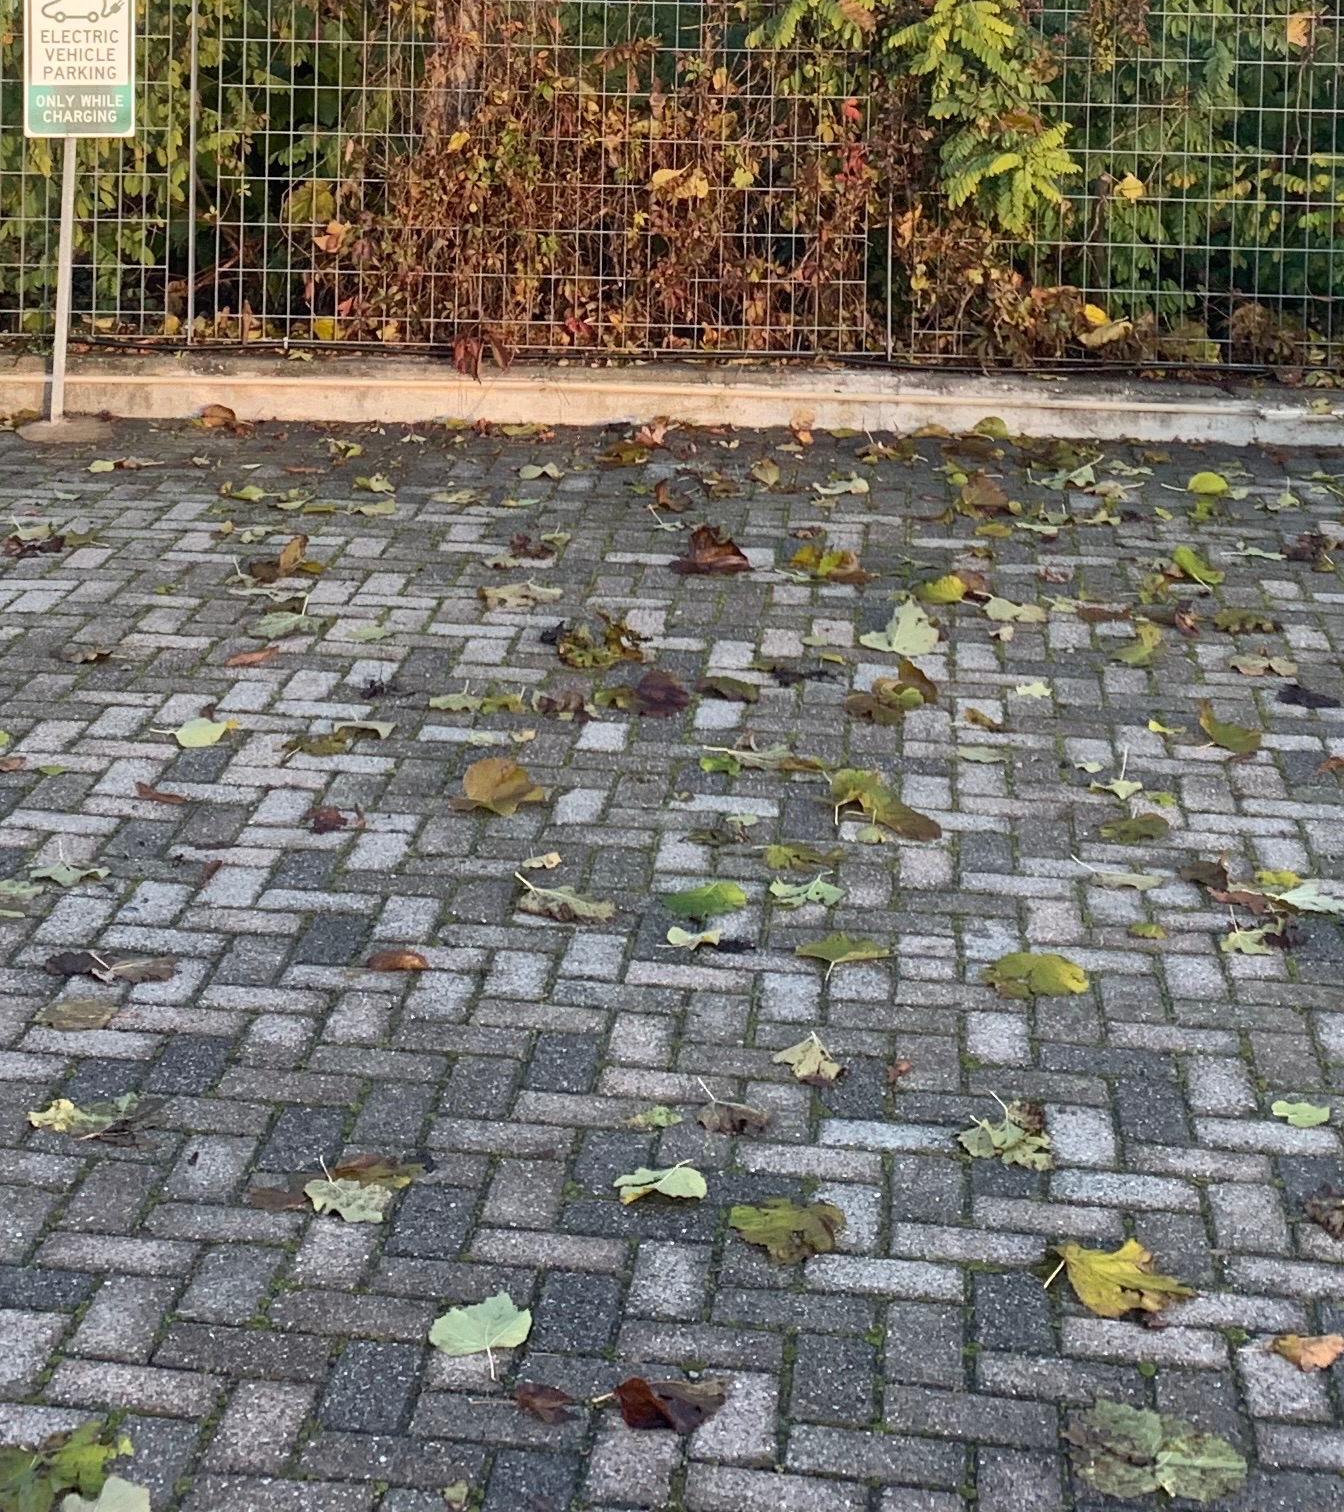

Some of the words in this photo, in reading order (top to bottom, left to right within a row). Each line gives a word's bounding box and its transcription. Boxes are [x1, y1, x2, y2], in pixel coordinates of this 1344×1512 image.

[41, 29, 119, 44] ELECTRIC
[45, 48, 116, 62] VEHICLE
[43, 66, 117, 80] PARKING
[36, 94, 75, 108] ONLY
[81, 94, 125, 108] WHILE
[43, 110, 117, 123] CHARGING
